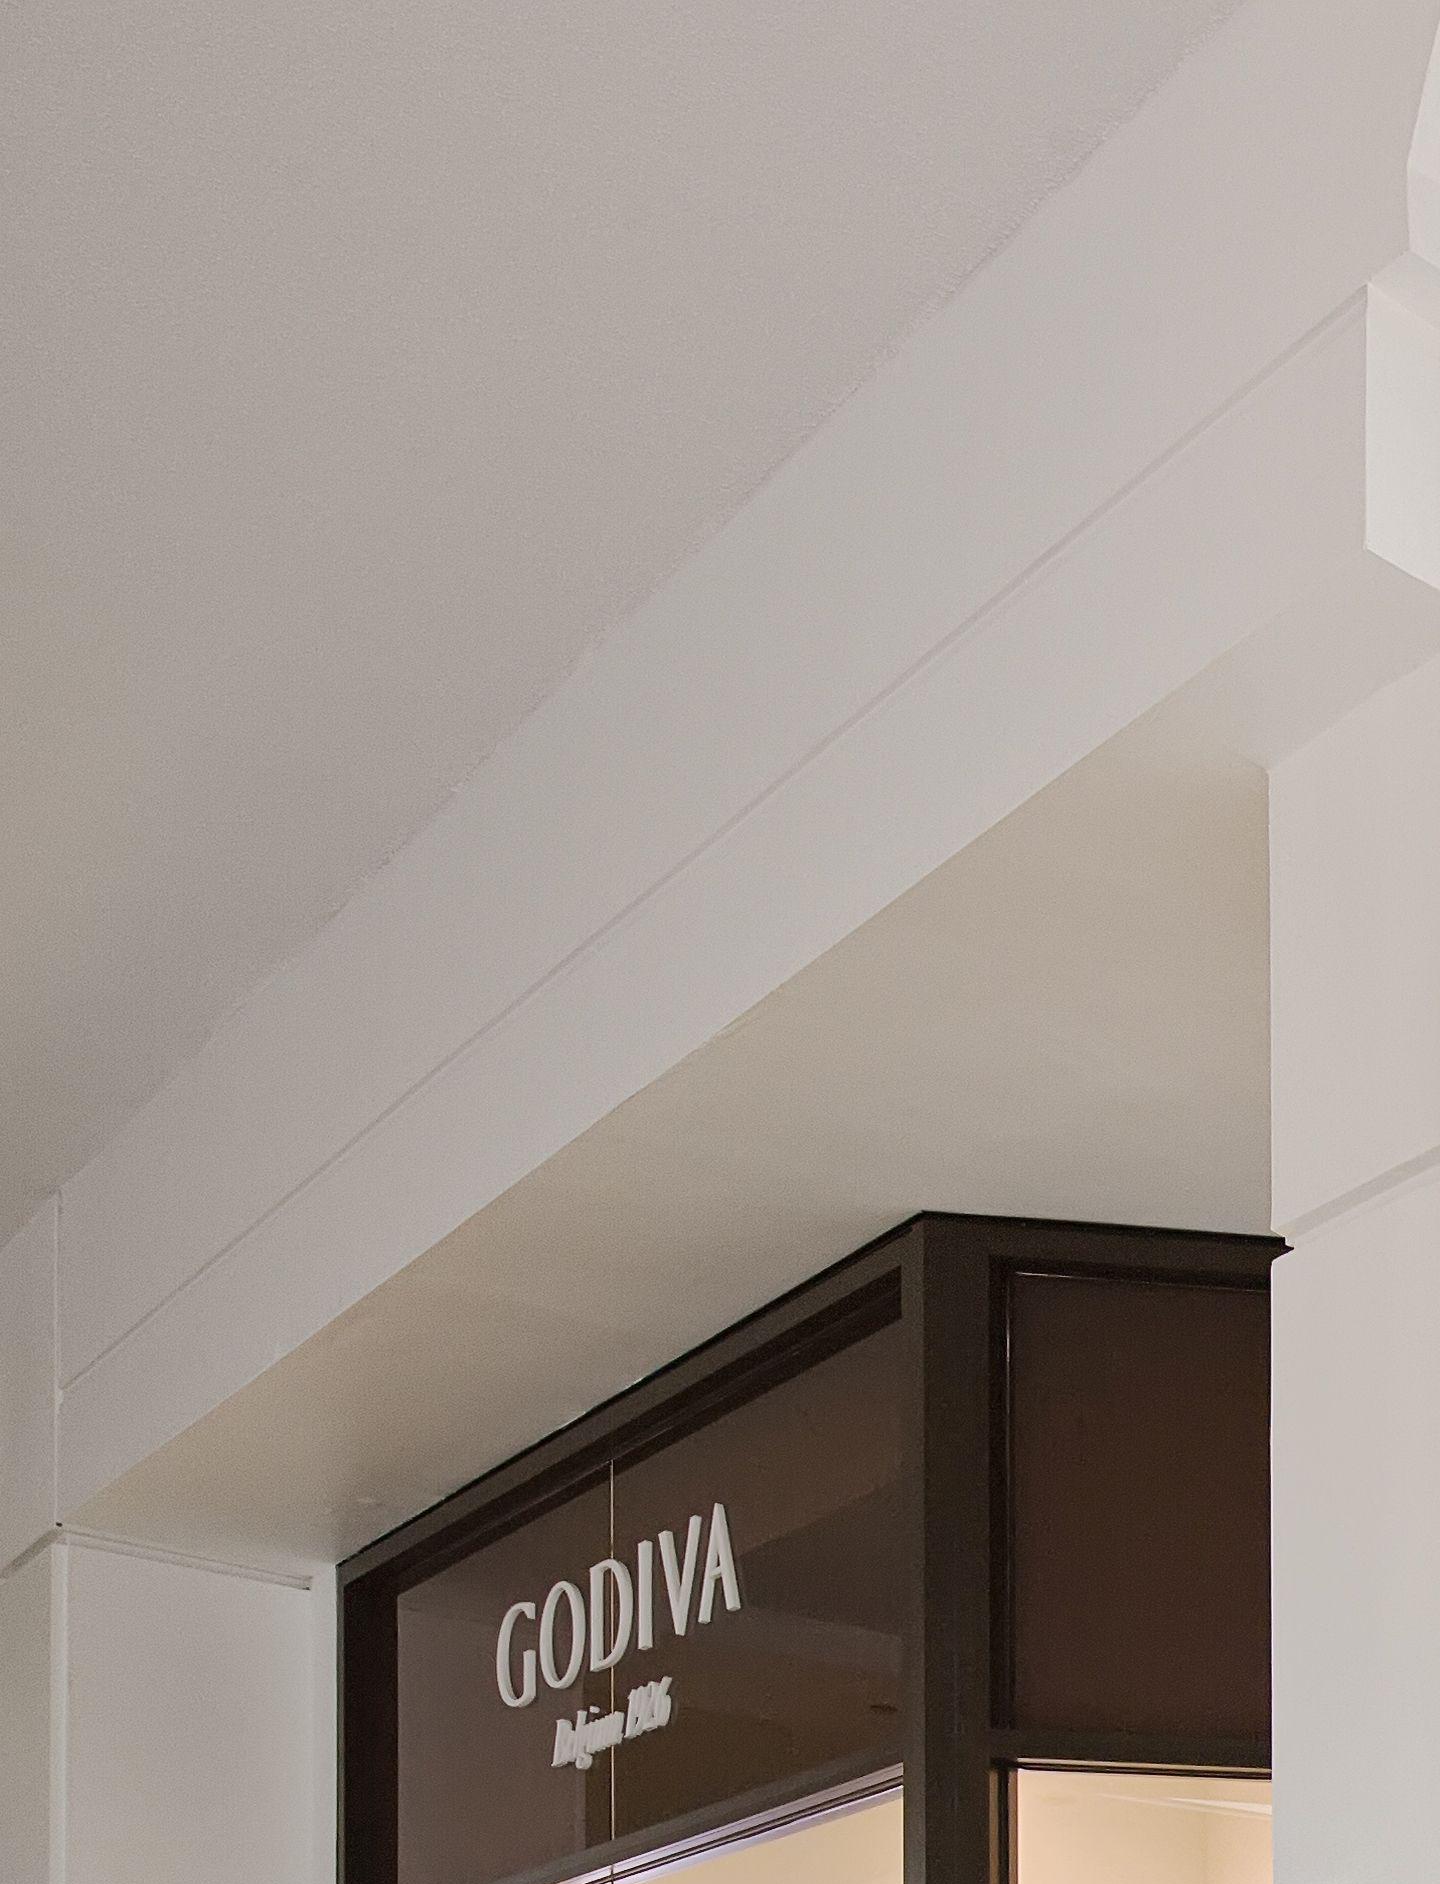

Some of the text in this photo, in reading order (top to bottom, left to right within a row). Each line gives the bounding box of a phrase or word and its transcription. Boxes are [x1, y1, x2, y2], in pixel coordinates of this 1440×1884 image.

[496, 1502, 742, 1708] GODIVA
[551, 1676, 673, 1770] Belgium 1926
